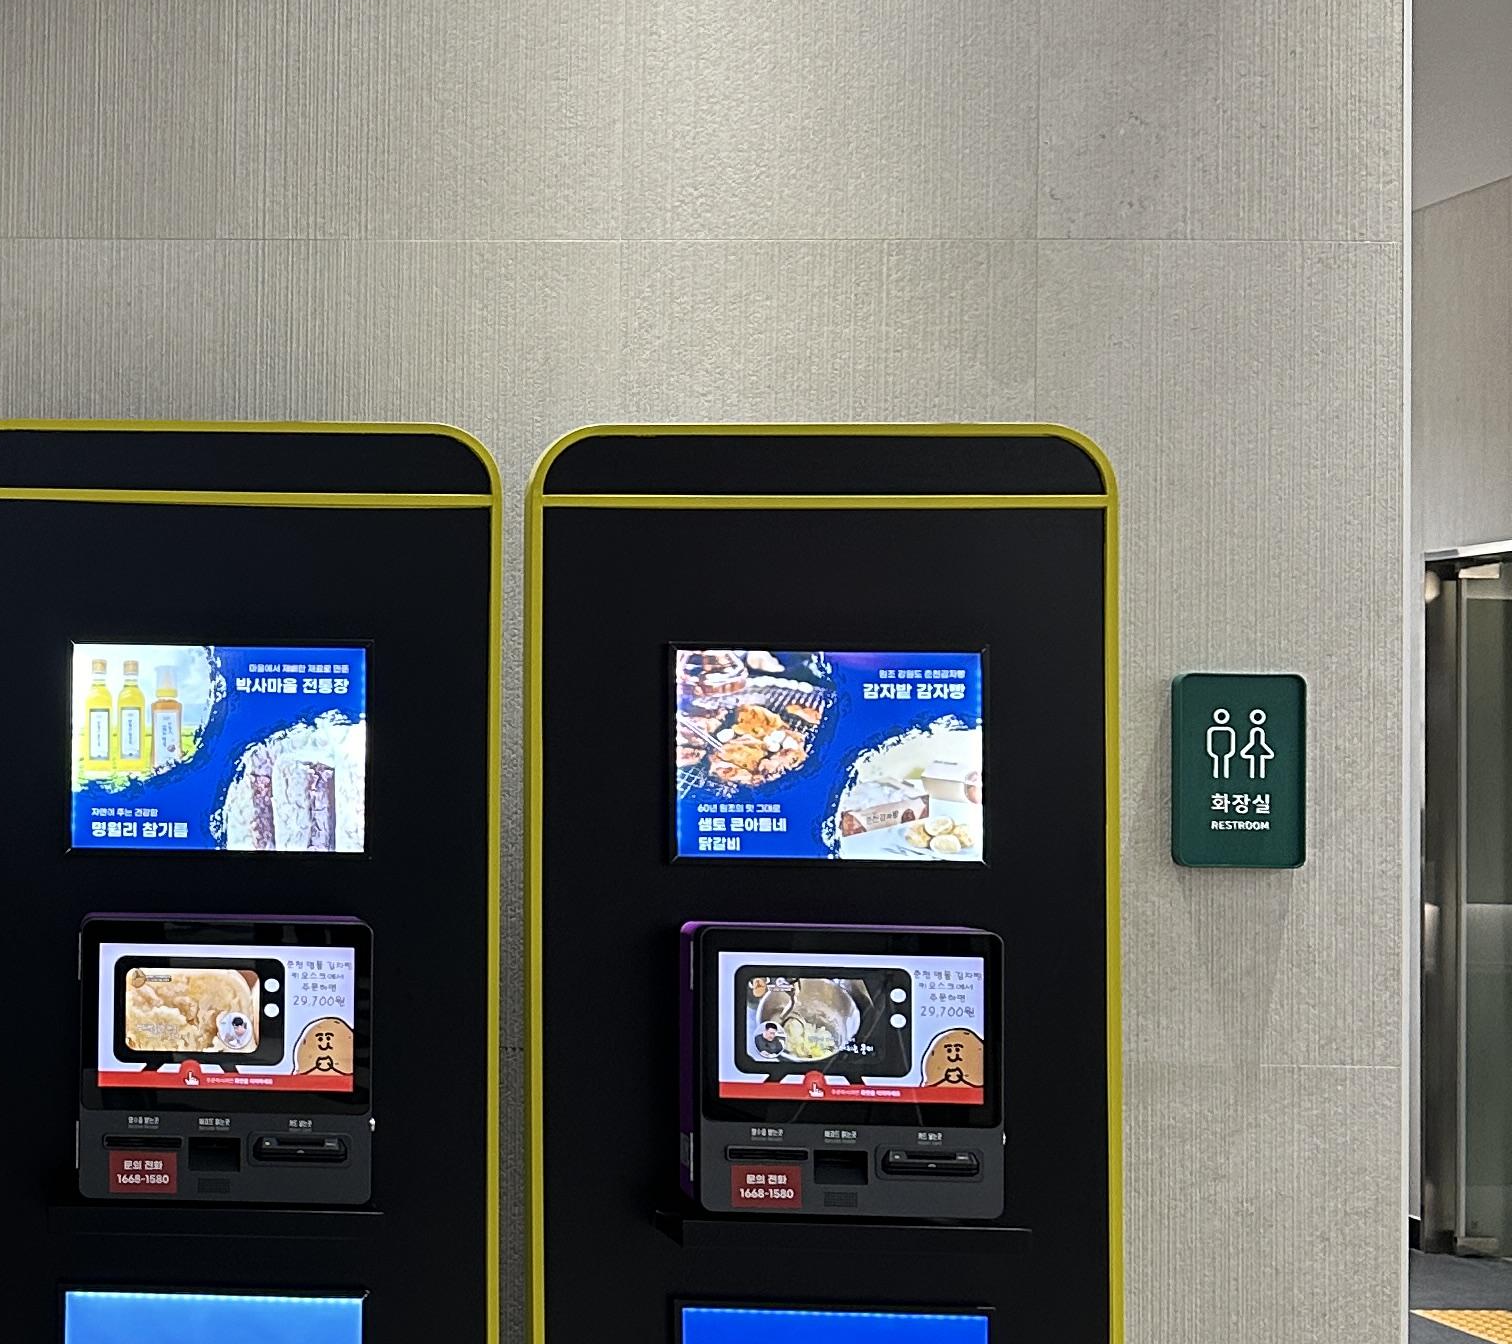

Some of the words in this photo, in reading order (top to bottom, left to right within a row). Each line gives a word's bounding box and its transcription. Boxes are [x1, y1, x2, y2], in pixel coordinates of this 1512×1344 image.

[236, 677, 298, 693] 박사마을
[302, 678, 350, 694] 전통장
[916, 683, 966, 700] 감자빵
[1210, 793, 1271, 815] 화장실
[91, 821, 138, 838] 명월리
[142, 821, 189, 838] 참기름
[1211, 820, 1270, 830] RESTROOM
[698, 836, 741, 852] 닭갈비
[124, 1160, 142, 1170] 문의
[145, 1160, 163, 1170] 전화
[117, 1174, 169, 1184] 1668-1580
[746, 1174, 765, 1184] 문의
[768, 1174, 787, 1184] 전화
[740, 1188, 794, 1199] 1668-1580
